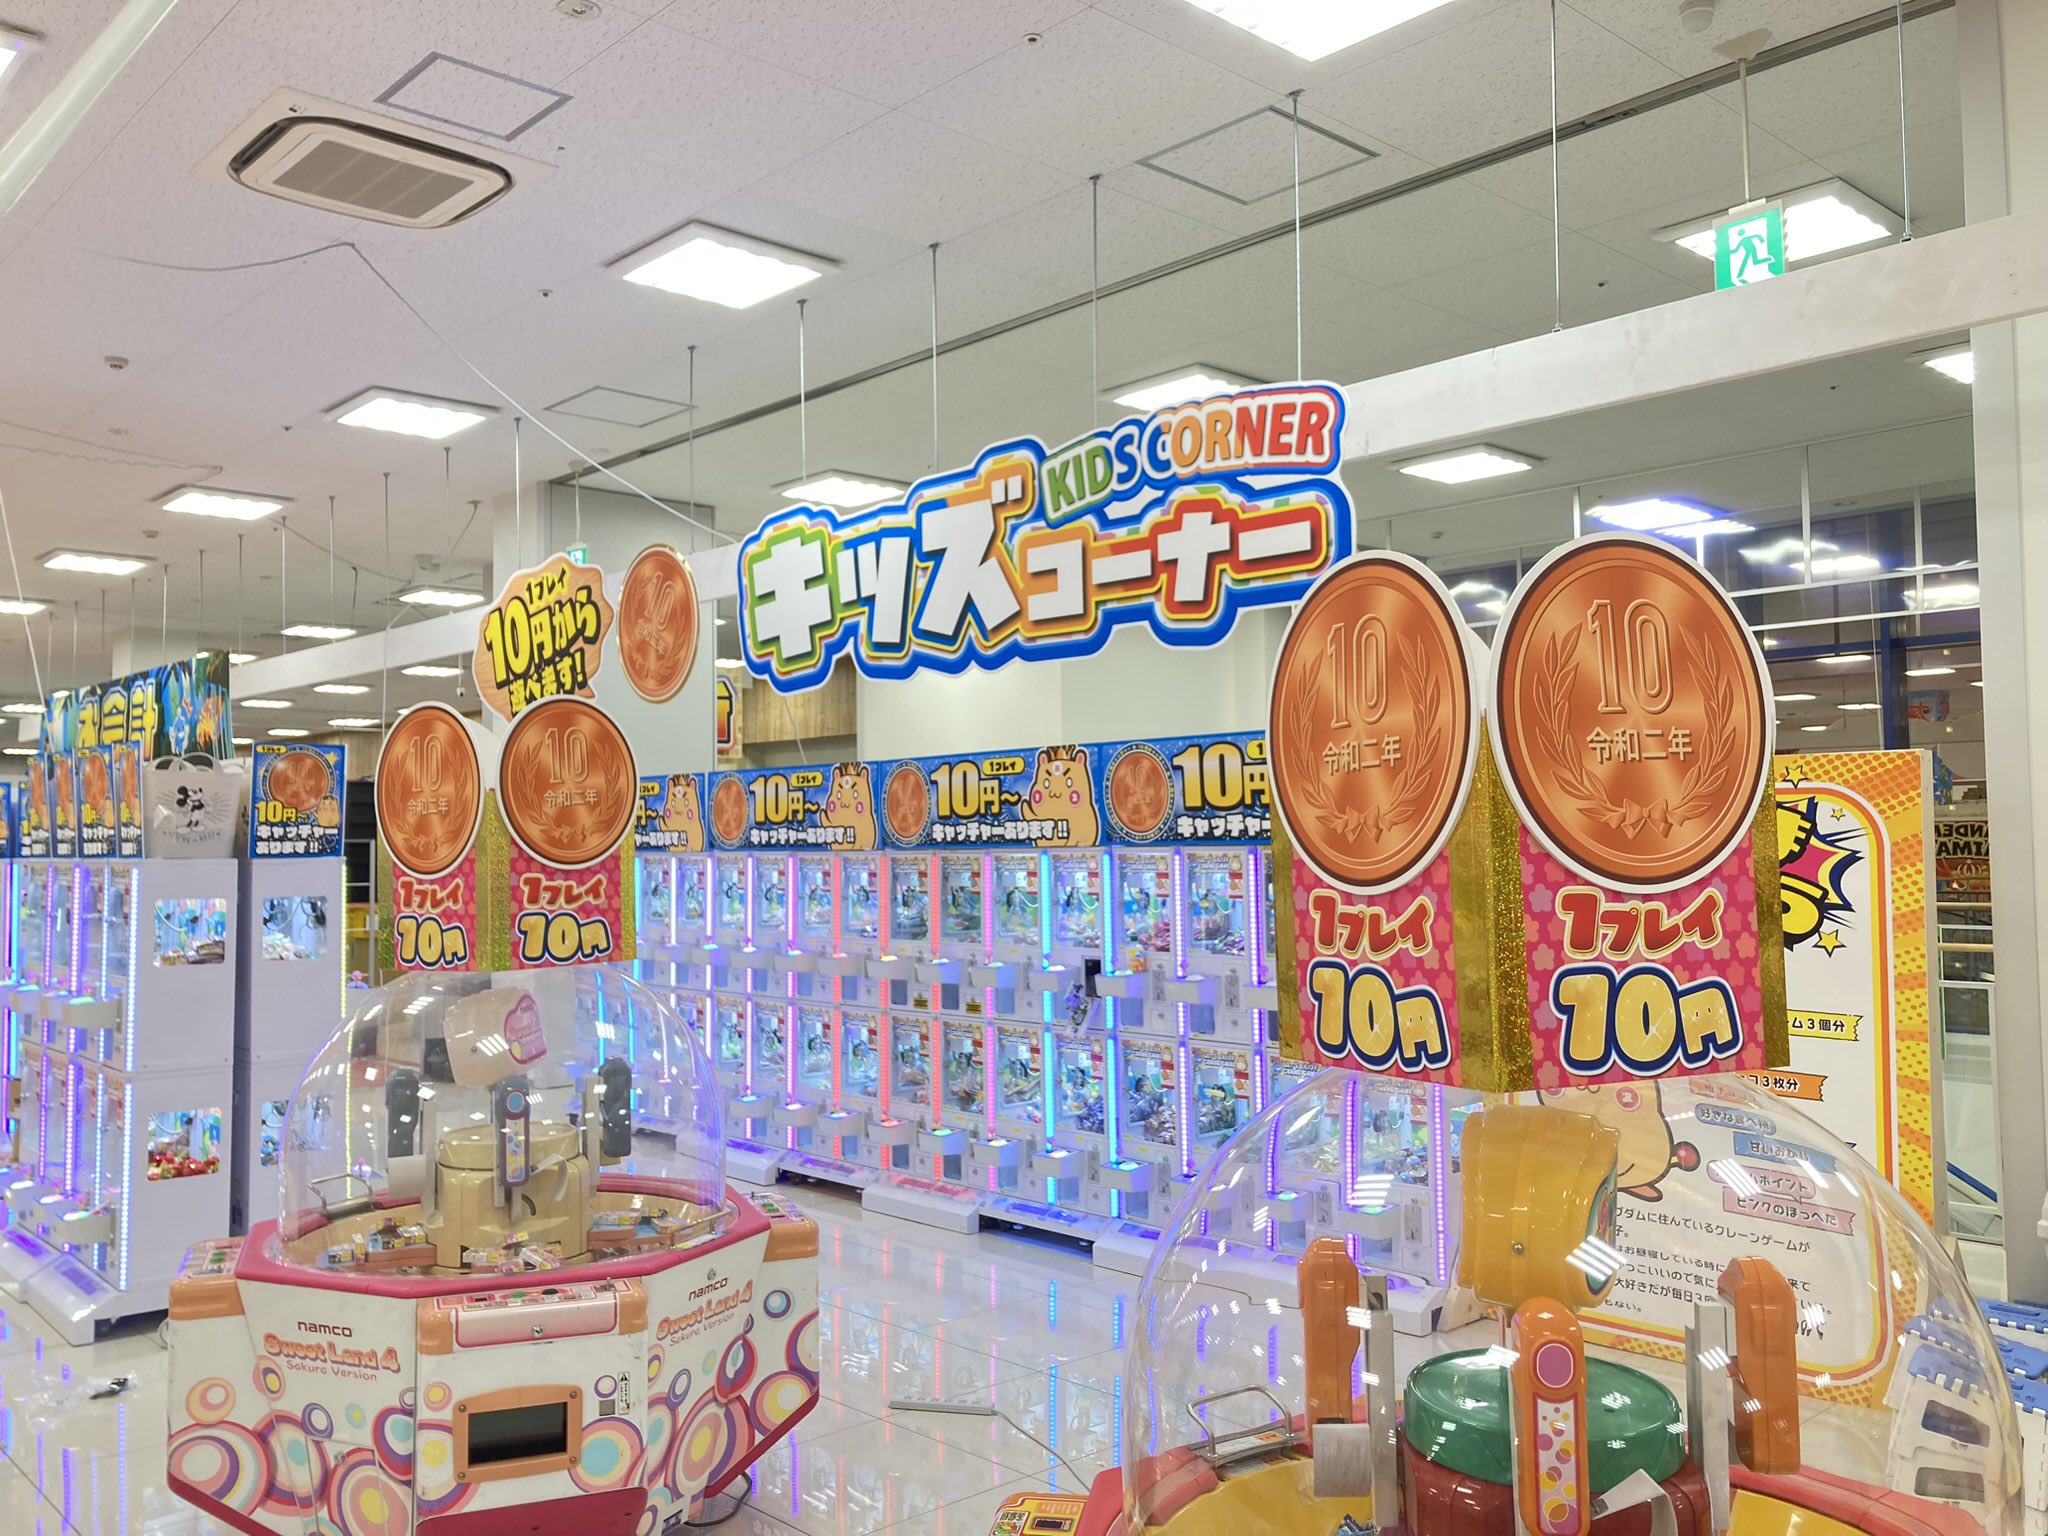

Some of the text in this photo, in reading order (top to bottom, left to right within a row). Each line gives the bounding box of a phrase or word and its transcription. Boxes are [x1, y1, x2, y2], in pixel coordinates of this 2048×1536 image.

[1047, 401, 1329, 511] KIDS CORNER
[525, 566, 567, 605] 1プレイ
[753, 474, 1312, 660] キッズコーナー
[644, 571, 675, 632] 10
[484, 585, 602, 690] 10円から
[1587, 598, 1674, 716] 10
[1326, 613, 1388, 730] 10
[409, 734, 443, 793] 10
[544, 727, 590, 784] 10
[1322, 732, 1402, 776] 令和二年
[1586, 726, 1693, 763] 令和二年
[407, 798, 450, 817] 令和二年
[543, 789, 599, 808] 令和二年
[399, 877, 464, 911] 1プレイ
[521, 873, 606, 907] 1プレイ
[397, 913, 468, 968] 10円
[518, 912, 612, 966] 10円
[1309, 889, 1434, 960] 1プレイ
[1555, 886, 1725, 960] 1プレイ
[1307, 959, 1450, 1072] 10円
[1551, 962, 1742, 1077] 10円
[1788, 1017, 1845, 1032] ム3個分
[1622, 1092, 1633, 1103] 2
[1742, 1075, 1798, 1091] コ3枚分
[656, 1279, 753, 1341] Sweet Land 4
[688, 1277, 729, 1301] namco
[263, 1333, 401, 1373] Sweet Land 4
[297, 1320, 353, 1338] namco
[670, 1312, 735, 1347] Sakura Version
[286, 1359, 378, 1382] Sakura Version
